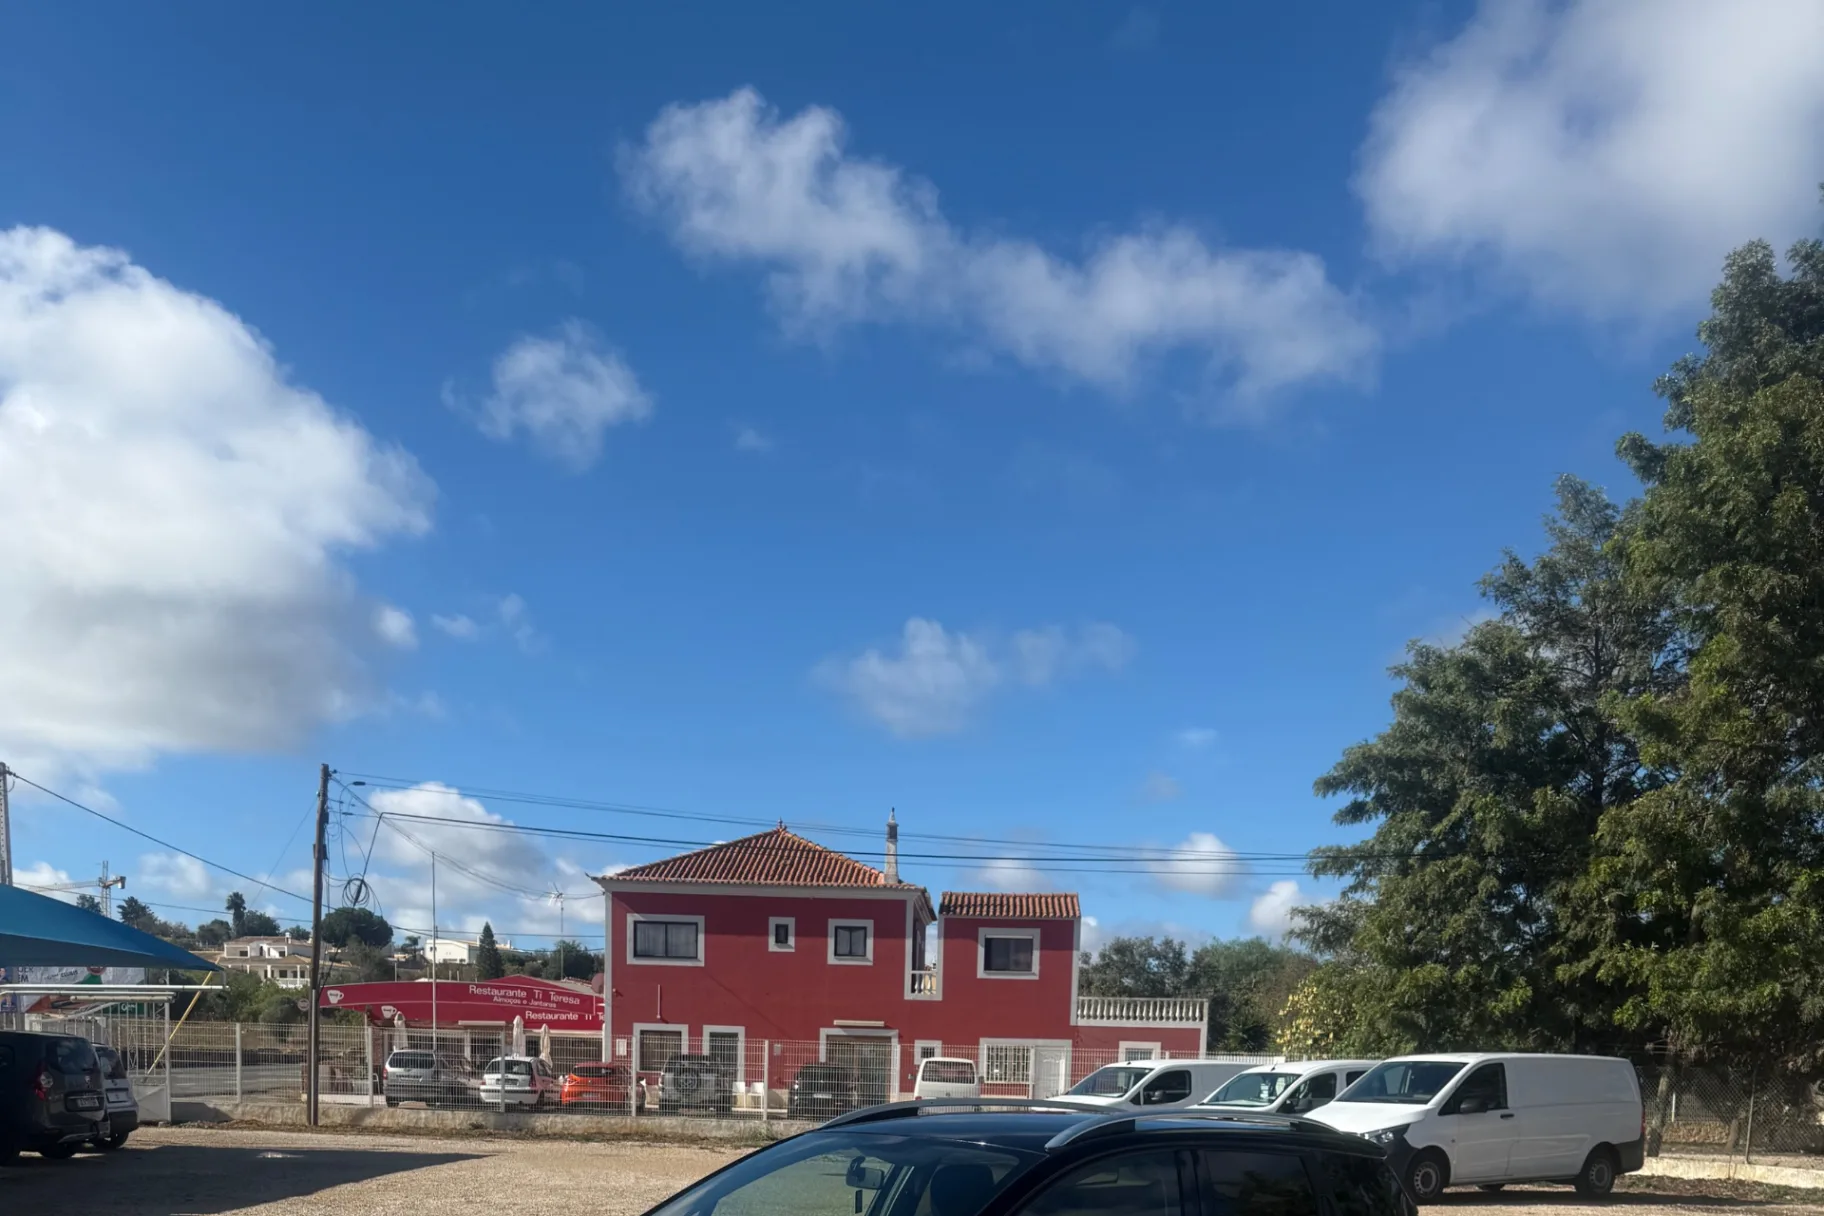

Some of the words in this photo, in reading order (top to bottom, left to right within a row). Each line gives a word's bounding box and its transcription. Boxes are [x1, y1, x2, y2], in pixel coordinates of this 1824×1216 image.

[469, 984, 527, 998] Restaurante
[533, 989, 543, 999] Ti
[549, 991, 580, 1005] Teresa
[493, 996, 521, 1005] Almoços
[525, 1010, 579, 1021] Restaurante
